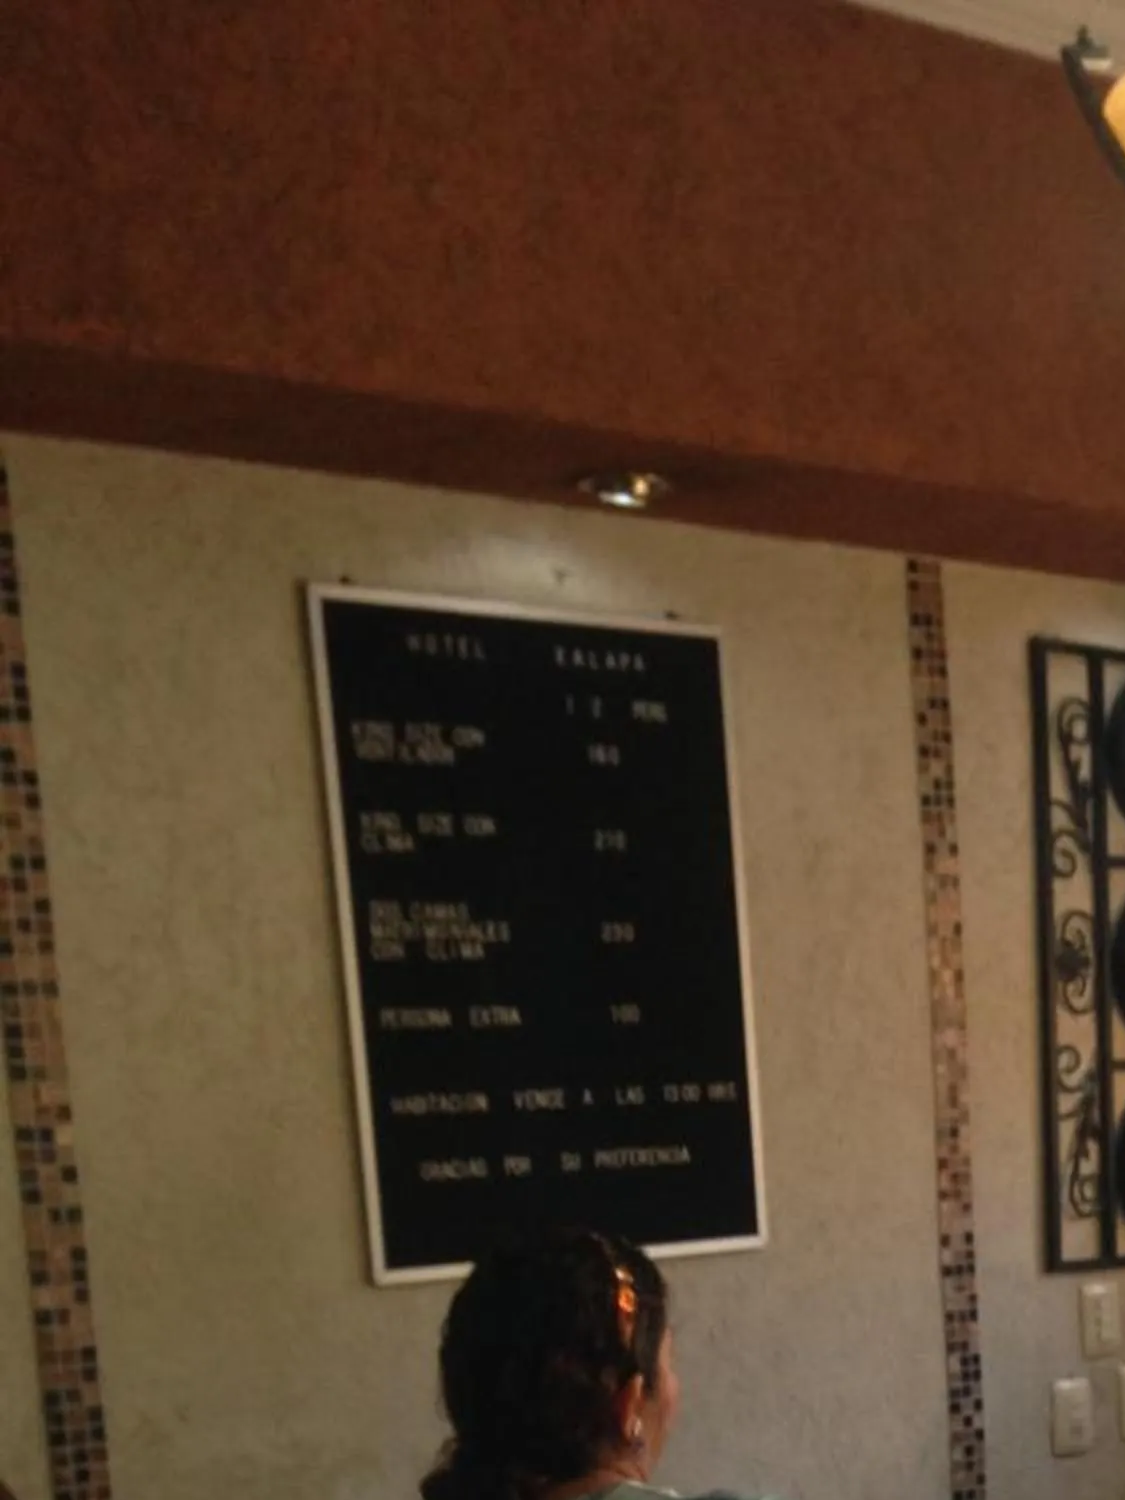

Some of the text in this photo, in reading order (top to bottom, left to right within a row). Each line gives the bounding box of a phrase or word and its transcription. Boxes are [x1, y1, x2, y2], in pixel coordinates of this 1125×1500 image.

[405, 633, 486, 661] HOTEL
[469, 1005, 522, 1028] EXTRA
[504, 1155, 532, 1176] POR
[560, 1152, 582, 1172] SU
[594, 1144, 691, 1168] PREFERENCIA
